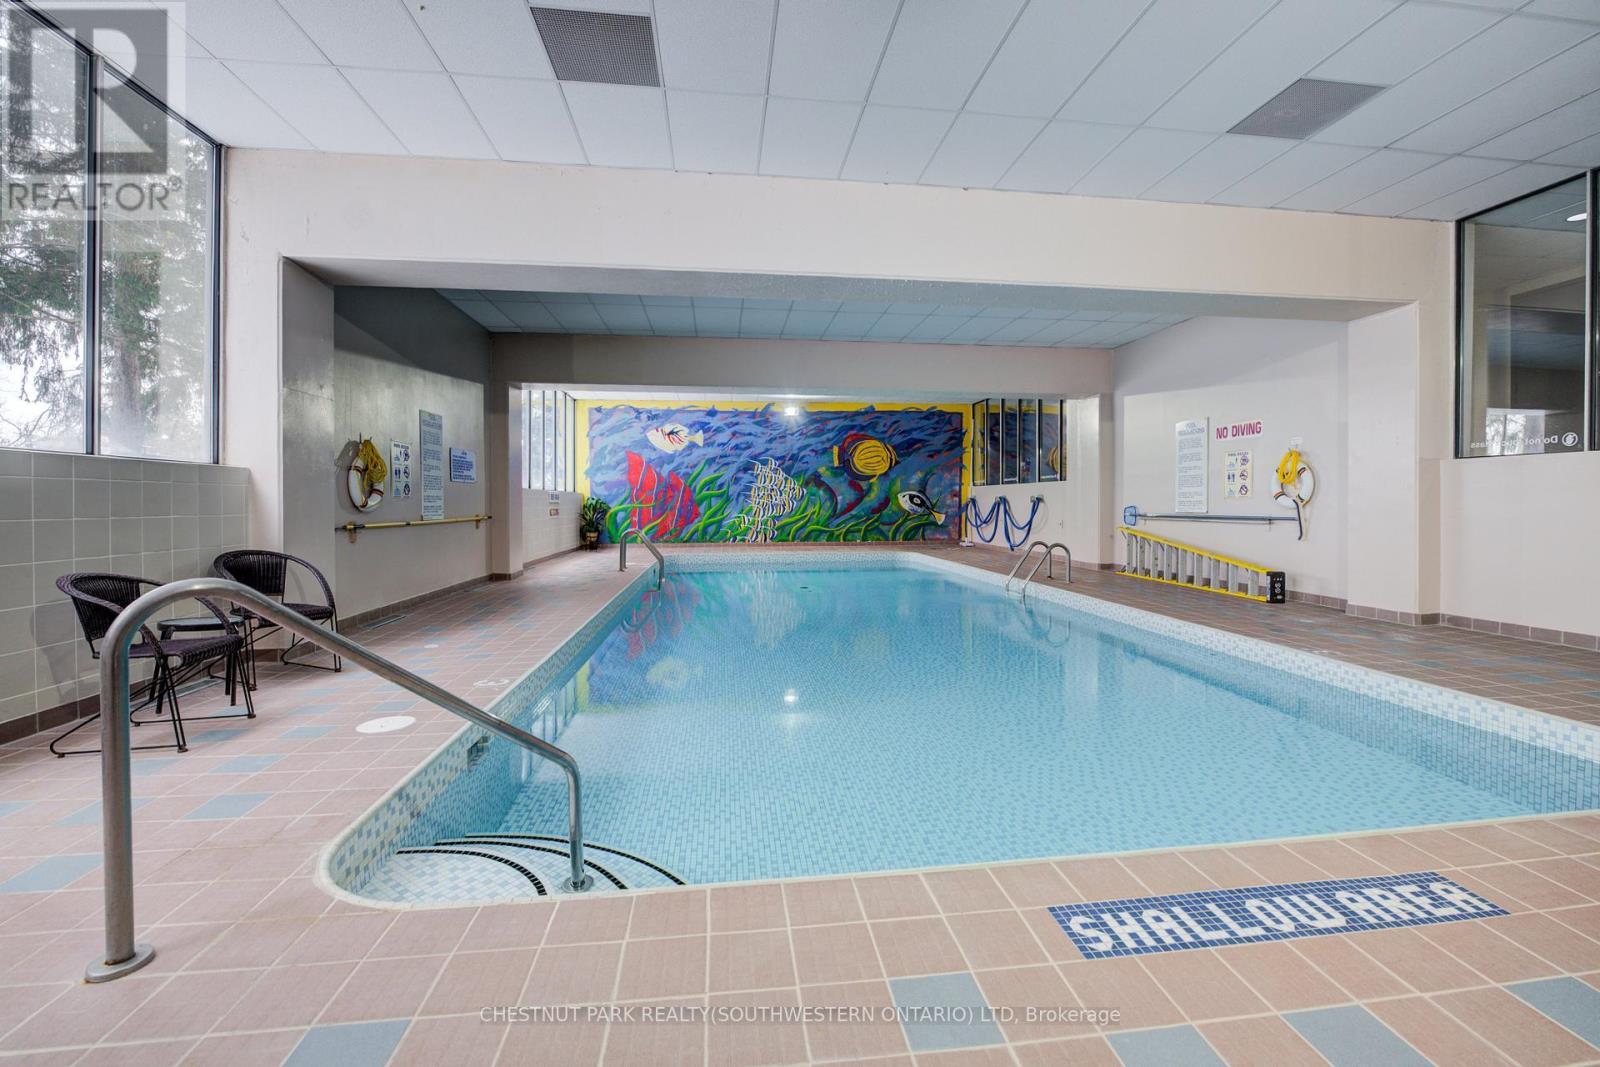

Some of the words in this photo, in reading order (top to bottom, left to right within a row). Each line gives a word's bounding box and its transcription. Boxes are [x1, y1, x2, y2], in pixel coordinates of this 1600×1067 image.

[1216, 426, 1228, 439] NO
[1231, 421, 1262, 437] DIVING
[1069, 893, 1348, 952] SHALLOW
[1335, 882, 1494, 927] AREA
